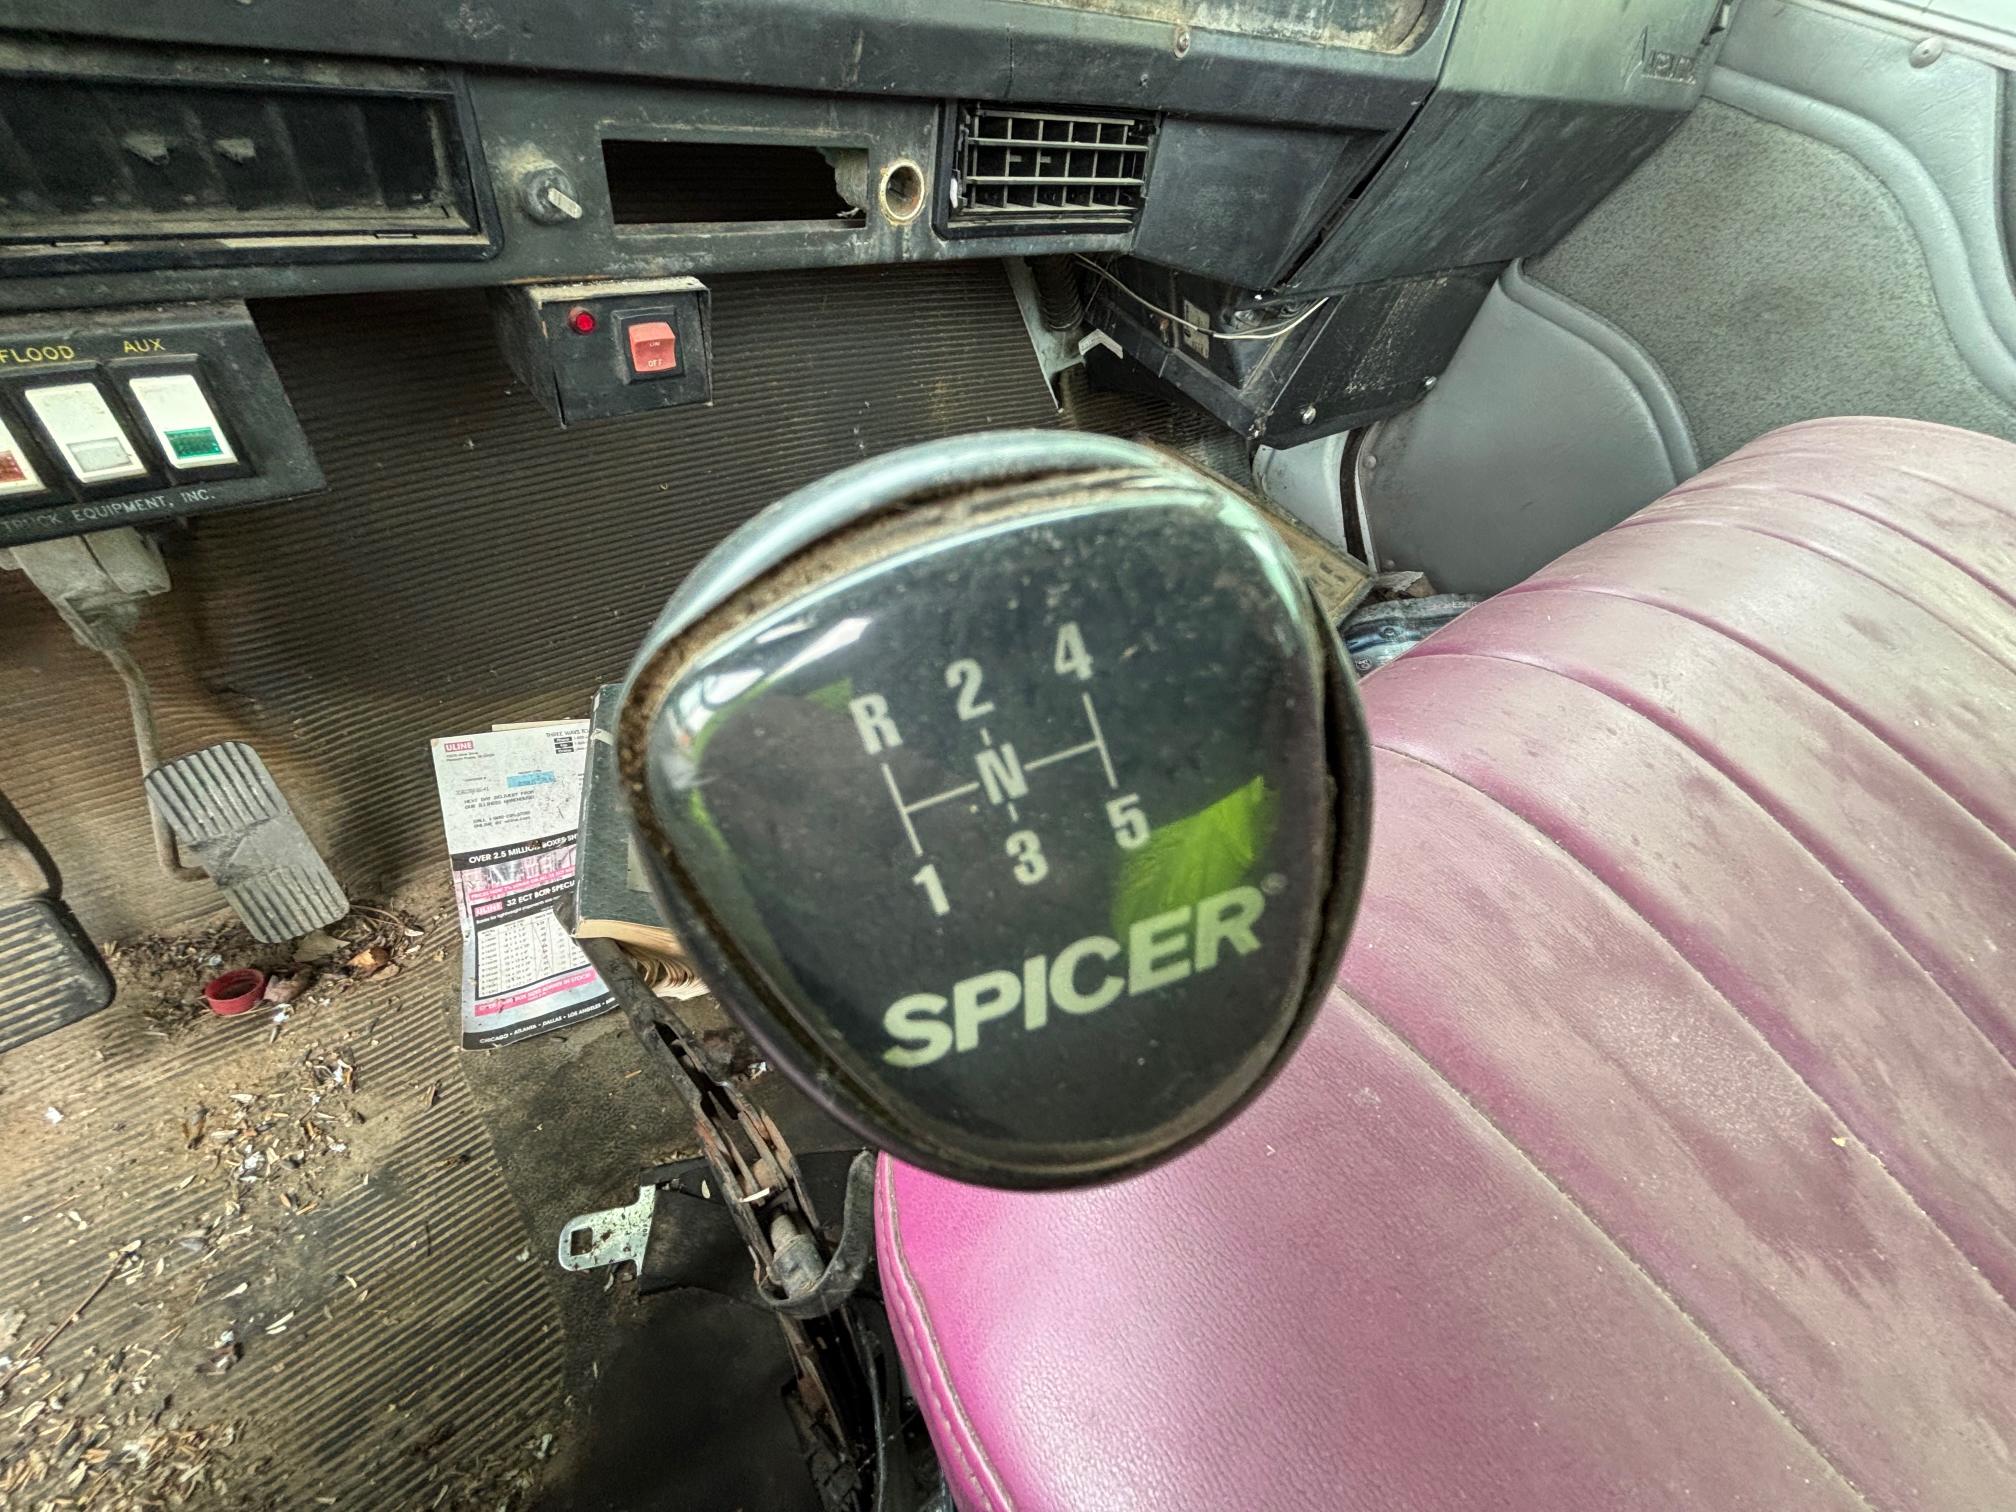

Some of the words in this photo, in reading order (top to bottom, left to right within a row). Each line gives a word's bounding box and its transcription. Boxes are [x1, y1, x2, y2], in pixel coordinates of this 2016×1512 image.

[0, 345, 75, 363] FLOOD
[123, 338, 166, 353] AUX
[648, 359, 663, 367] OFF
[71, 495, 175, 522] EQUIPMENT,
[180, 488, 216, 505] INC.
[1053, 621, 1093, 681] 4
[945, 658, 995, 720] 2
[849, 693, 902, 755] R
[445, 741, 473, 751] ULINE
[974, 743, 1030, 805] N
[1105, 794, 1150, 850] 5
[468, 852, 492, 864] OVER
[493, 850, 507, 861] 2.5
[508, 843, 542, 857] MILLIO
[1005, 830, 1049, 885] 3
[474, 902, 503, 916] ULINE
[506, 898, 517, 907] 32
[518, 893, 533, 903] ECT
[911, 864, 951, 916] 1
[881, 885, 1266, 1067] SPICER
[479, 1033, 509, 1043] CHICAGO
[514, 1024, 537, 1035] ATLANTA
[542, 1015, 562, 1027] DALLAS
[567, 1009, 578, 1018] LOS
[578, 1003, 601, 1015] ANGELES
